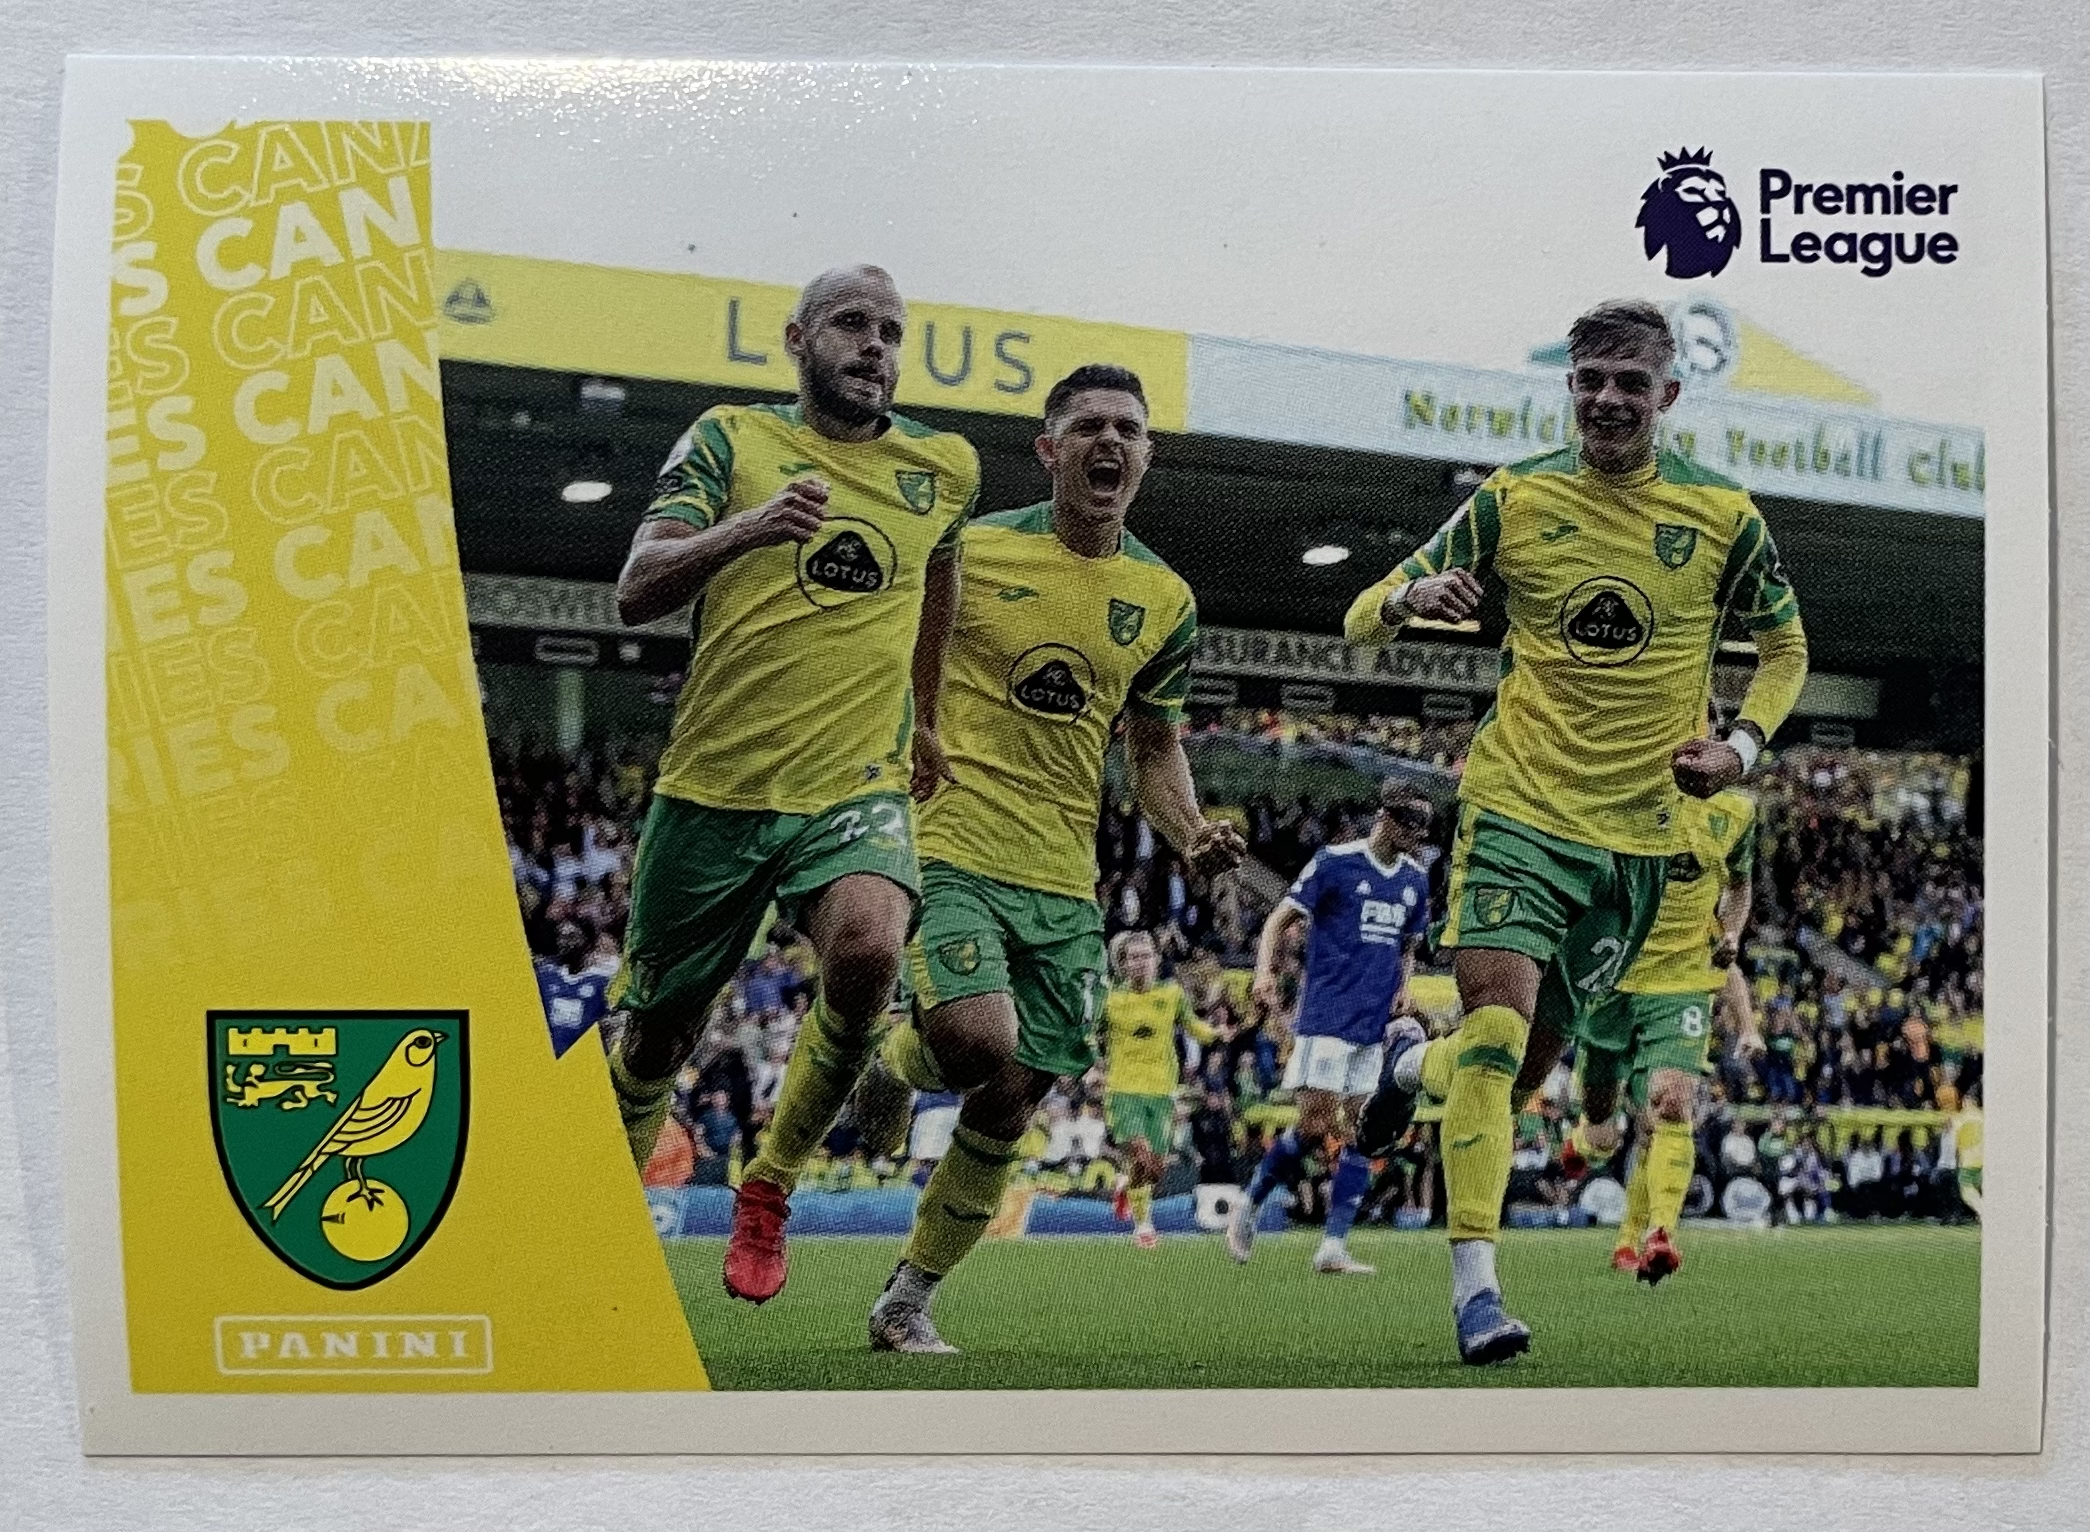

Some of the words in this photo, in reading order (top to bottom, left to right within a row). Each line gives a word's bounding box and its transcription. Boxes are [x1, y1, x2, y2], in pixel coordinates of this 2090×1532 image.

[1760, 168, 1958, 215] Premier
[195, 175, 422, 291] CAN
[1760, 217, 1959, 278] League
[726, 296, 1035, 395] LUS
[811, 559, 879, 589] LOTUS
[1575, 620, 1638, 642] LOTUS
[1020, 684, 1081, 710] LOTUS
[1680, 1005, 1703, 1038] 8
[238, 1329, 470, 1359] PANINI
